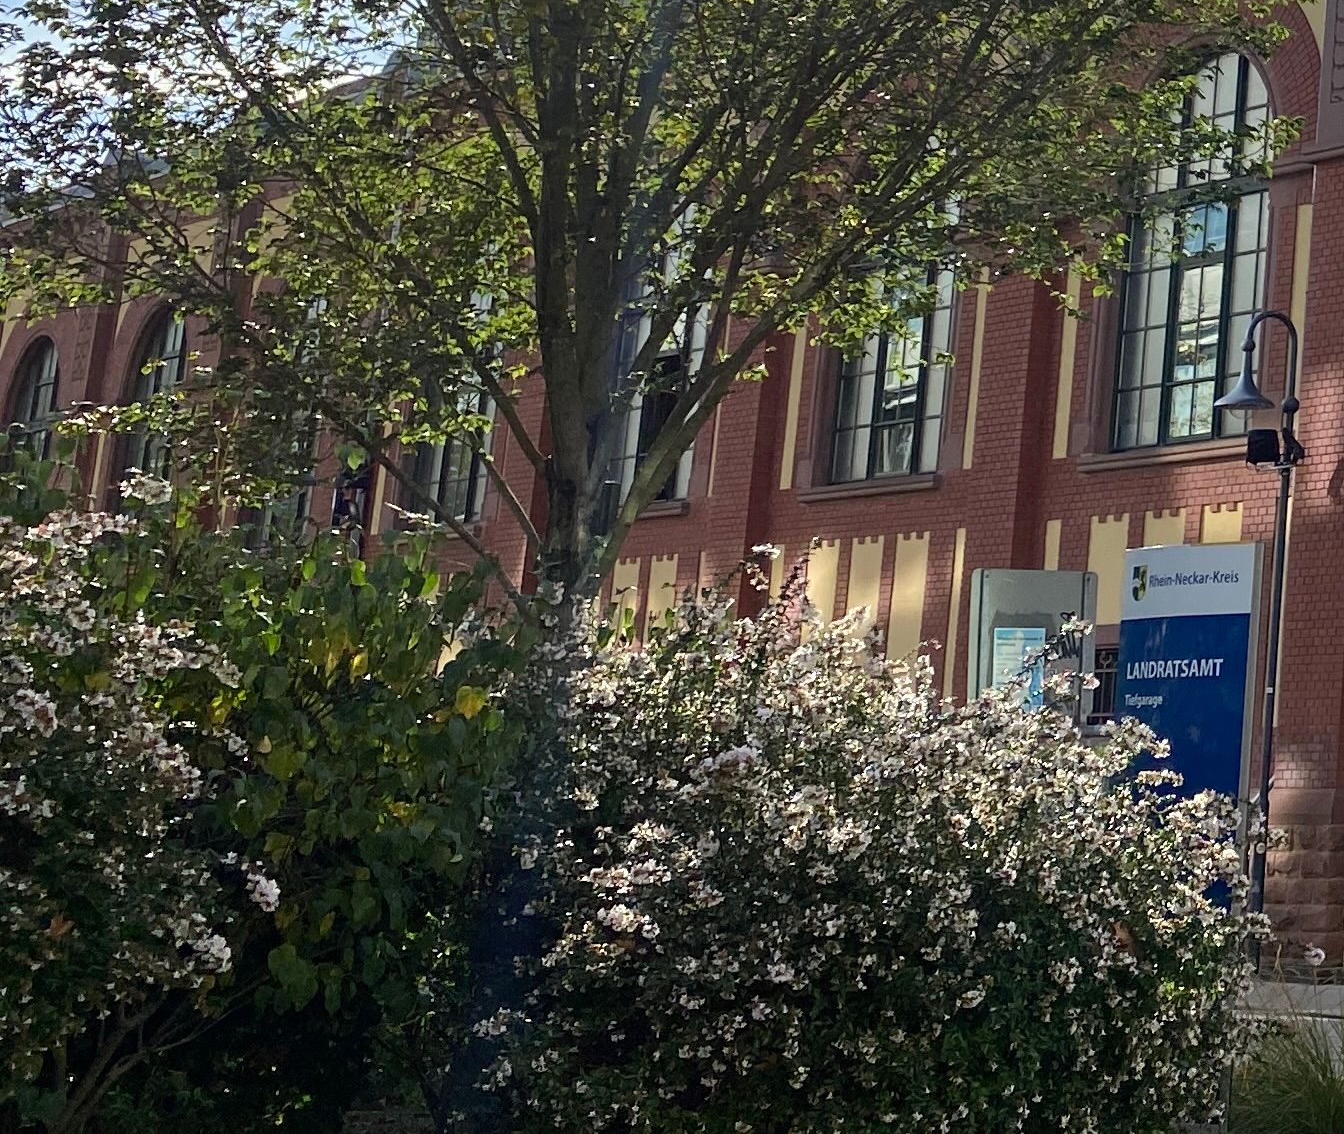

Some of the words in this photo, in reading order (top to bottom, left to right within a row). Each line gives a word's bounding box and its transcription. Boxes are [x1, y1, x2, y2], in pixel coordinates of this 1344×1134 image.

[1149, 570, 1239, 588] Rhein-Neckar-Kreis
[1126, 658, 1224, 680] LANDRATSAMT
[1124, 693, 1163, 709] Tiefgarage
